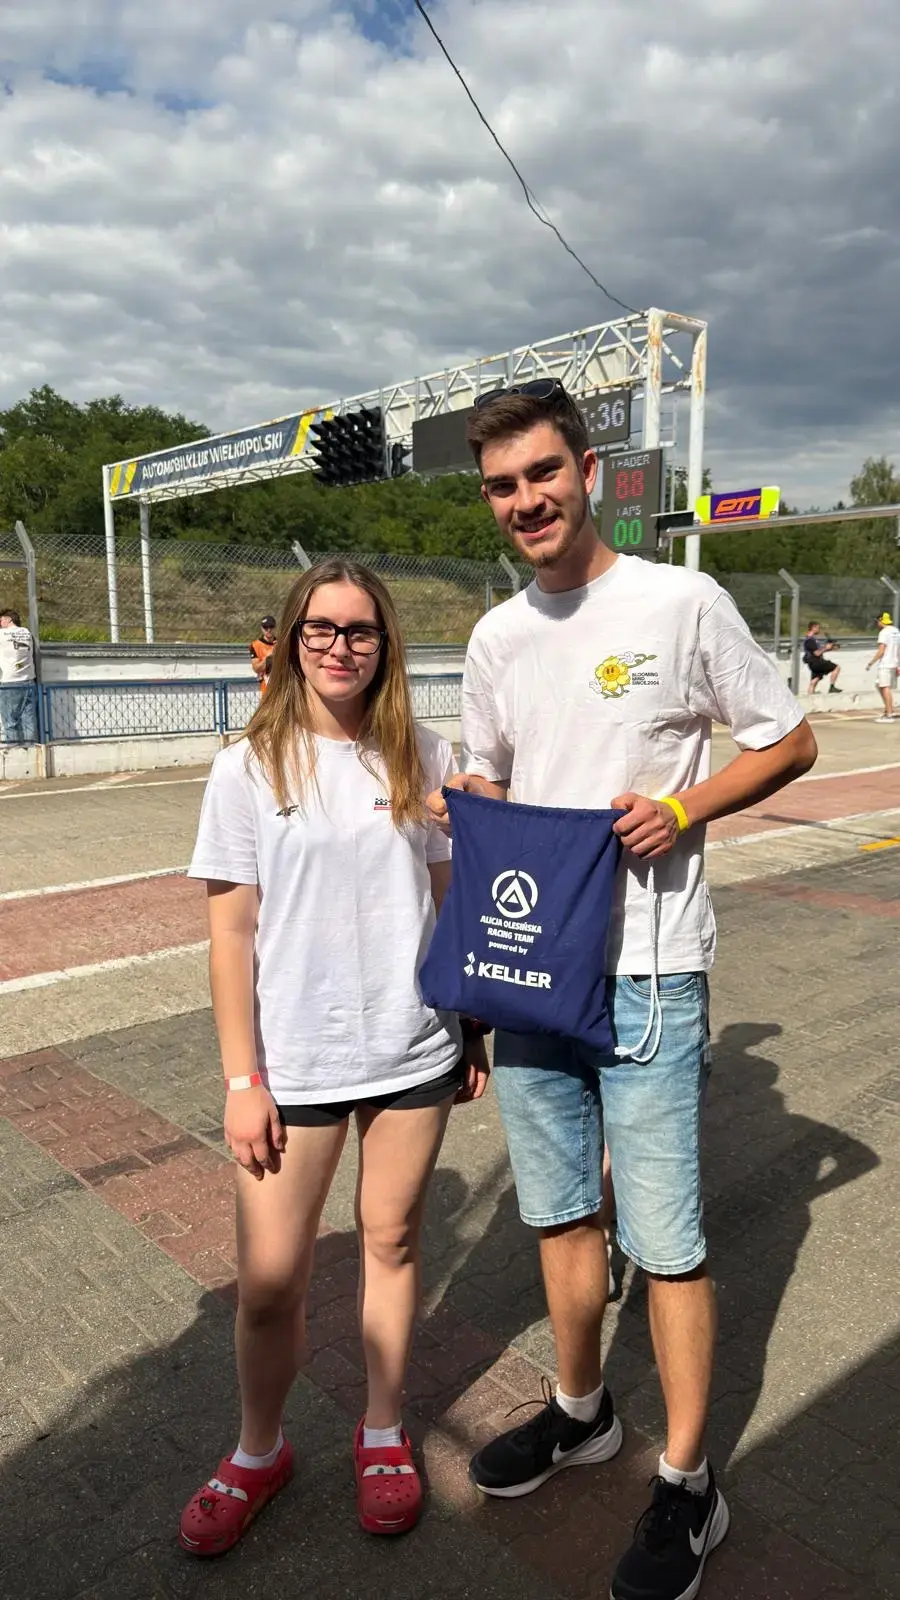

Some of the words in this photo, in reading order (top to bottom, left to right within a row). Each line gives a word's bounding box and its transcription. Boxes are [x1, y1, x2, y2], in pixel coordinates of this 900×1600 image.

[142, 452, 209, 480] AUTOMOBILKLUB
[209, 431, 283, 464] WIELKOPOLSKI
[613, 518, 643, 547] 00
[487, 927, 513, 939] RACING
[514, 932, 535, 943] TEAM
[488, 941, 518, 953] powered
[518, 945, 529, 955] by
[477, 961, 552, 989] KELLER
